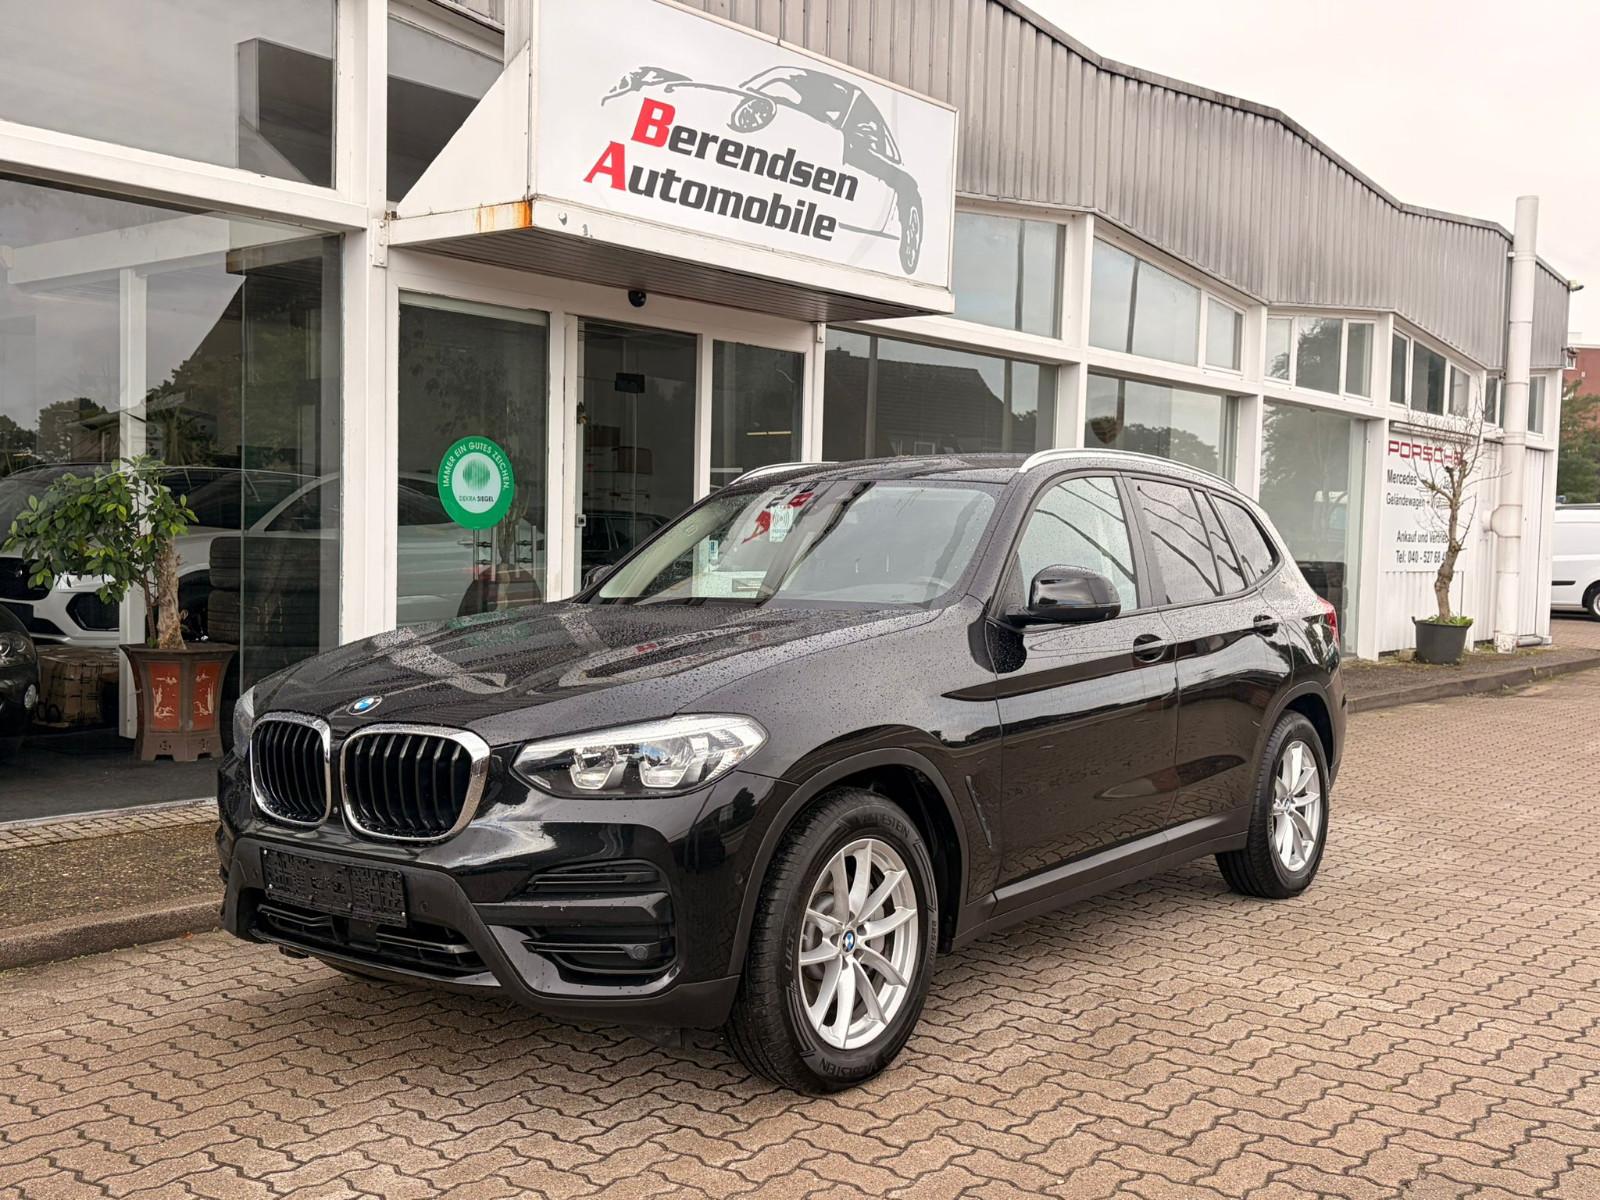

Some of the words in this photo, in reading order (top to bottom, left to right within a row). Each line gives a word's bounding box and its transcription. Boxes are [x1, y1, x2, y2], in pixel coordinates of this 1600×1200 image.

[631, 97, 859, 201] Berendsen
[583, 141, 838, 241] Automobile
[443, 456, 456, 487] IMMER
[454, 444, 468, 457] EIN
[468, 442, 493, 454] GUTES
[1387, 469, 1417, 486] Mercedes
[1386, 492, 1425, 510] Geländewagen
[1396, 530, 1417, 543] Ankauf
[1418, 531, 1428, 543] und
[1407, 550, 1419, 563] 040
